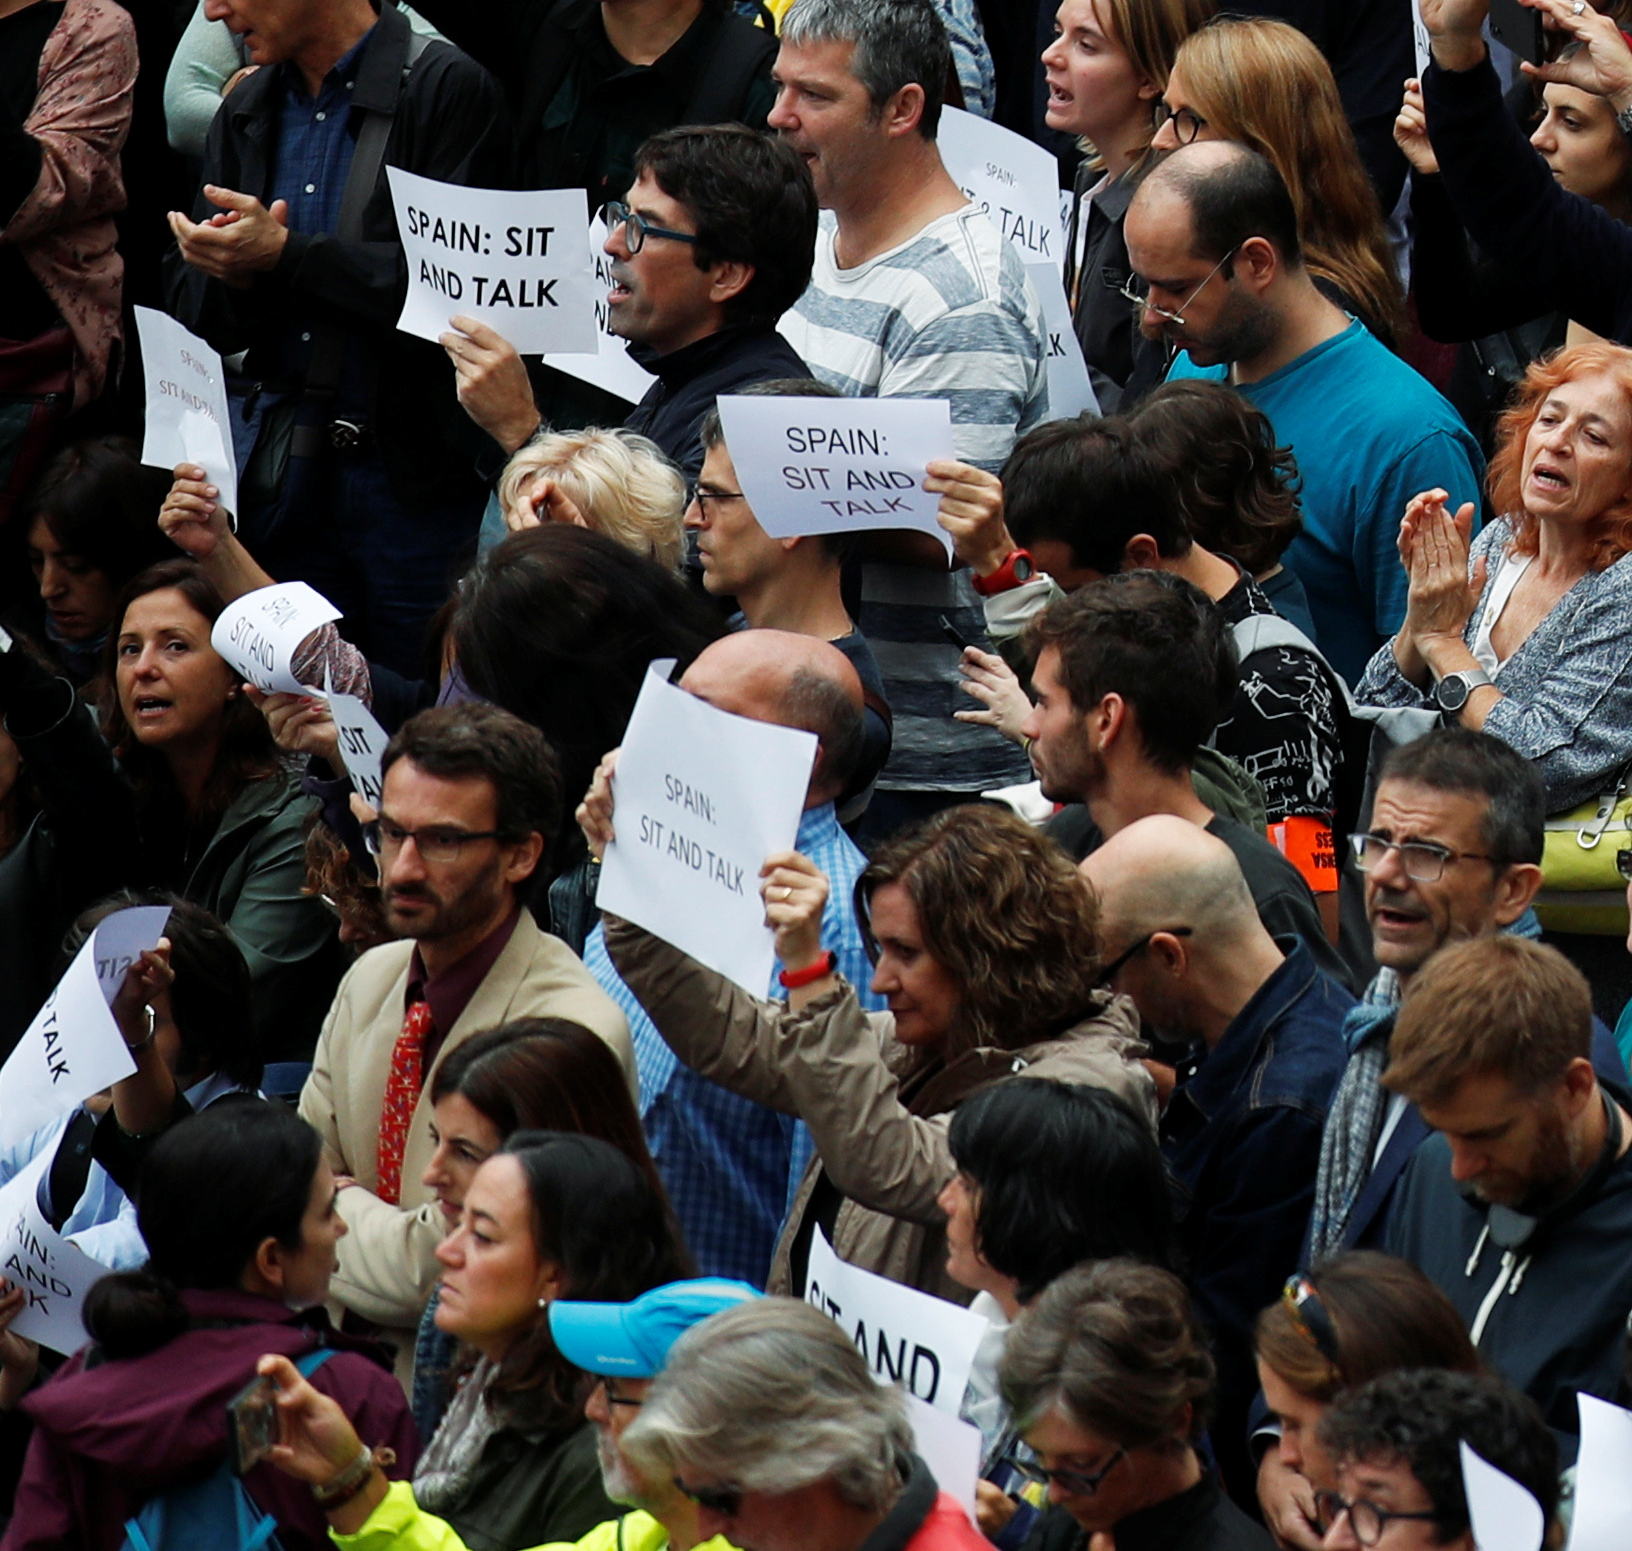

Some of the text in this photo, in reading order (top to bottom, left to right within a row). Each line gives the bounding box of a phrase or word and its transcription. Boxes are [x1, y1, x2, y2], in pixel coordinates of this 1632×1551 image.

[985, 162, 1017, 189] SPAIN:
[407, 205, 555, 257] SPAIN: SIT
[1000, 206, 1051, 257] TALK
[420, 258, 560, 308] AND TALK
[785, 426, 889, 457] SPAIN:
[782, 465, 915, 491] SIT AND
[821, 496, 914, 517] TALK
[231, 616, 275, 672] SIT AND
[341, 726, 374, 756] SIT
[664, 771, 717, 827] SPAIN:
[639, 813, 744, 896] SIT AND TALK
[42, 1011, 71, 1085] TALK
[5, 1253, 72, 1299] AND
[854, 1318, 941, 1405] AND
